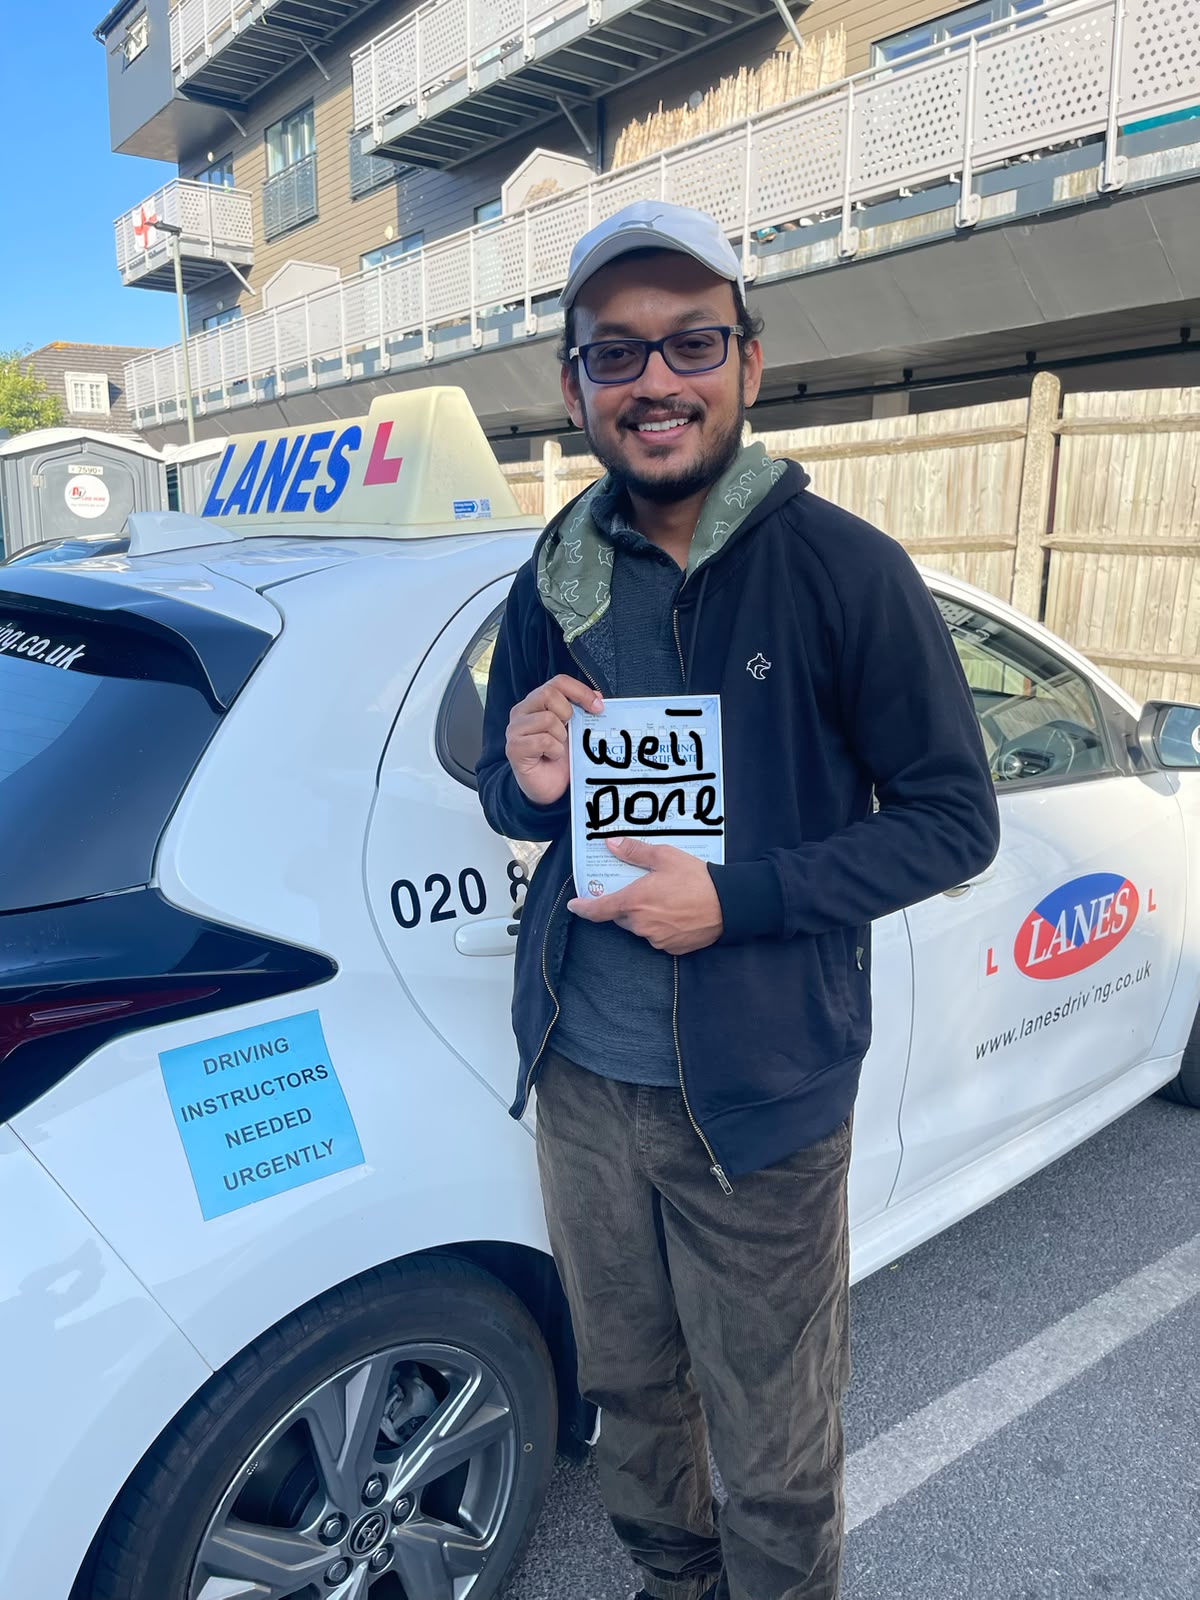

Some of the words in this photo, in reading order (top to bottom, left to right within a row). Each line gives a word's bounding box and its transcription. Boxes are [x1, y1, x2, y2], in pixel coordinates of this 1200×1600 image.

[201, 425, 362, 518] LANES
[362, 420, 403, 486] L
[0, 622, 86, 670] ing.co.uk
[390, 867, 487, 929] 020
[985, 947, 999, 977] L
[1025, 887, 1130, 968] LANES
[1147, 888, 1157, 913] L
[203, 1037, 290, 1075] DRIVING
[180, 1064, 329, 1123] INSTRUCTORS
[224, 1107, 312, 1149] NEEDED
[223, 1138, 334, 1191] URGENTLY
